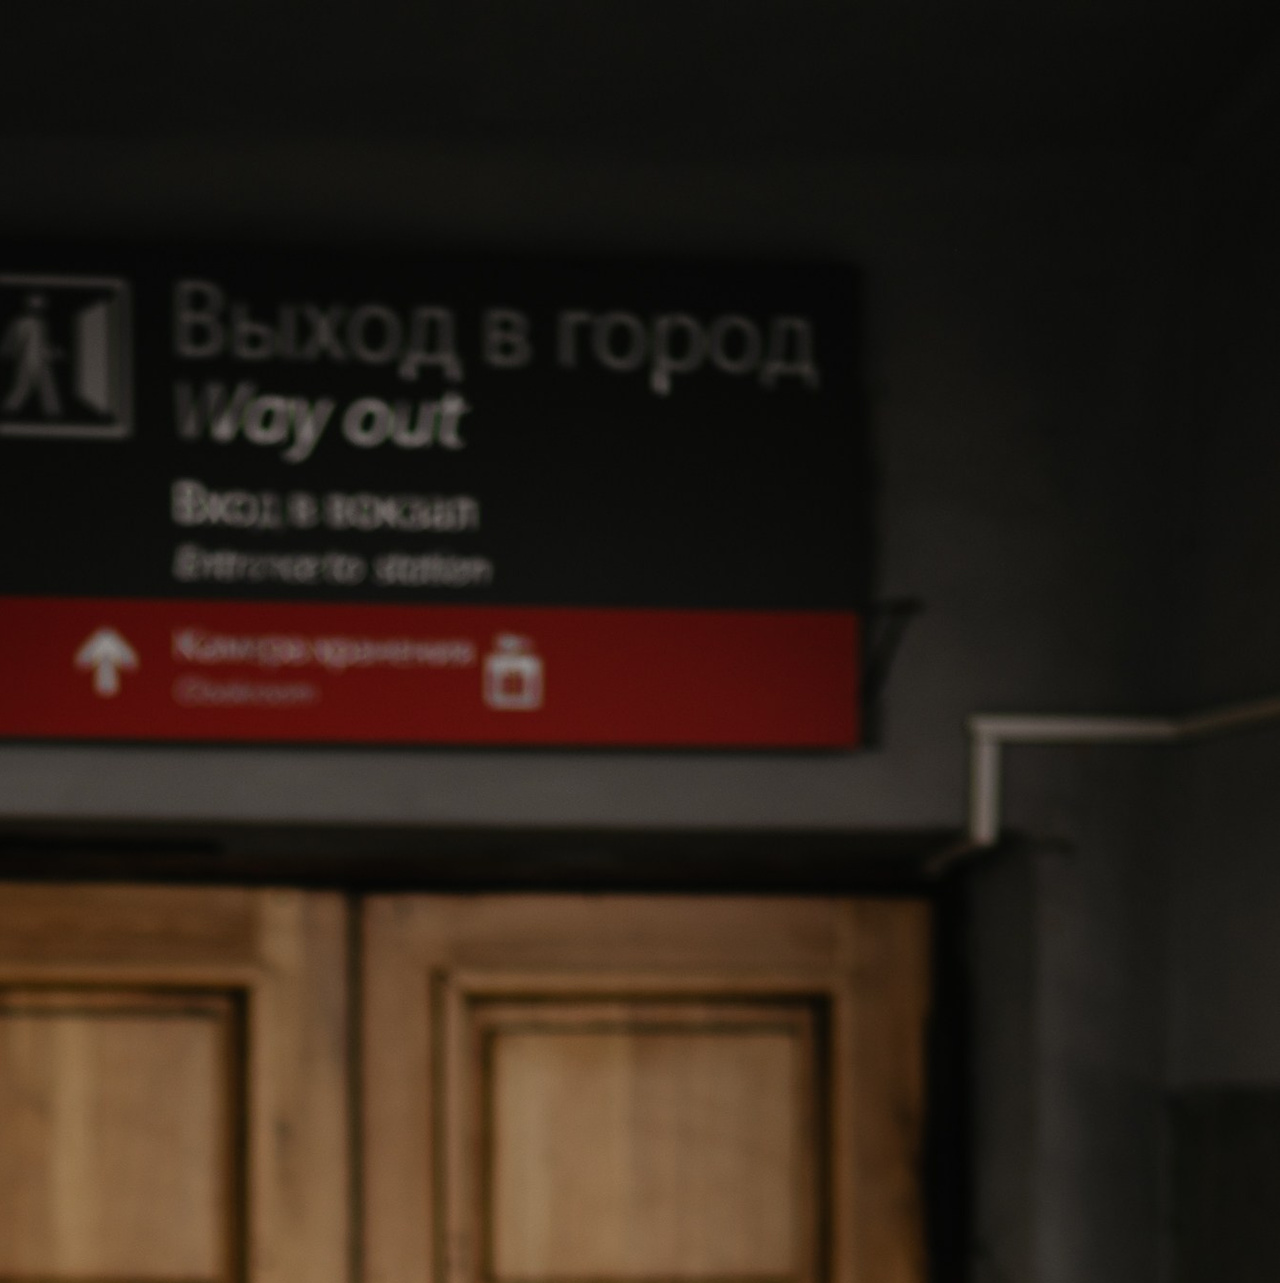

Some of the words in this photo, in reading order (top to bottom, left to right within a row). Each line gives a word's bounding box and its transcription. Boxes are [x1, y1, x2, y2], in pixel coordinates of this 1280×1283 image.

[172, 278, 466, 383] Выход
[481, 306, 532, 368] в
[556, 308, 820, 396] город
[173, 379, 335, 463] Way
[341, 390, 473, 451] out
[170, 477, 285, 534] Вход
